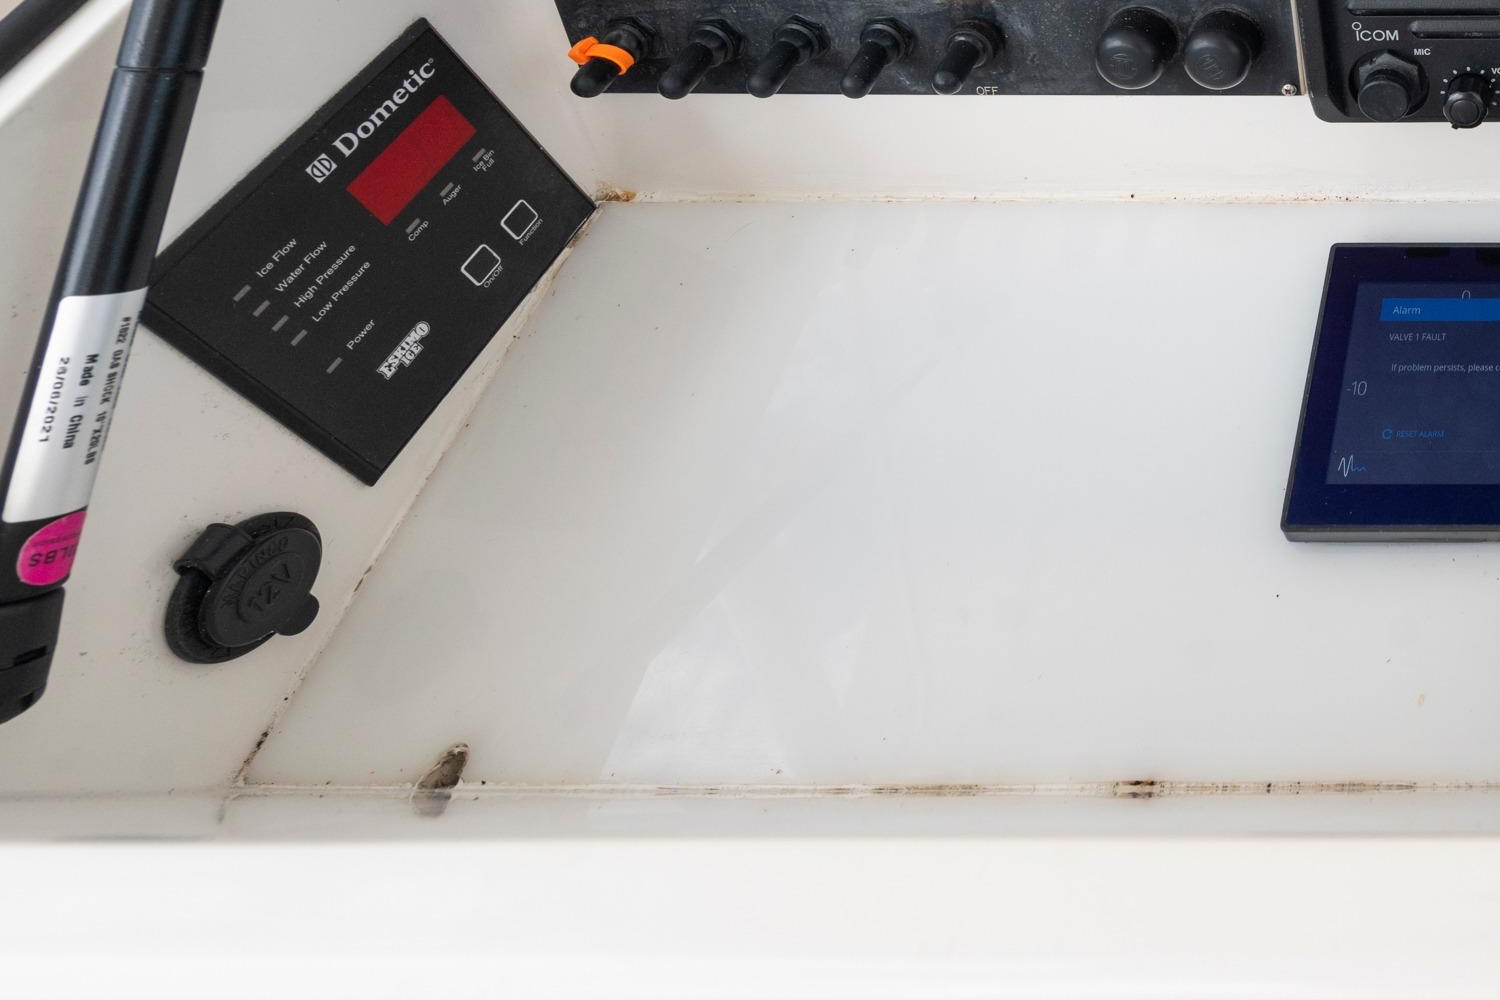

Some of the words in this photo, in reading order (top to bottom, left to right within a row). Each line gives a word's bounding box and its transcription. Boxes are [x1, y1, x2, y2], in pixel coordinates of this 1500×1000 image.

[976, 86, 999, 95] OFF
[331, 60, 435, 158] Dometic
[472, 161, 484, 172] Ice
[483, 150, 495, 161] Bin
[481, 159, 495, 172] Full
[442, 184, 462, 207] Auger
[408, 220, 429, 242] Comp
[518, 218, 543, 246] Function
[256, 262, 274, 278] Ice
[272, 238, 297, 263] Flow
[274, 263, 305, 293] Water
[303, 241, 327, 265] Flow
[293, 284, 318, 308] High
[315, 245, 356, 285] Pressure
[483, 265, 504, 288] On/Off
[312, 301, 333, 322] Low
[331, 261, 371, 302] Pressure
[1392, 306, 1421, 315] Alarm
[346, 319, 376, 350] Power
[1389, 333, 1413, 341] VALVE
[1421, 333, 1447, 341] FAULT
[79, 354, 99, 386] Made
[1391, 363, 1398, 372] If
[1398, 363, 1432, 373] problem
[1434, 363, 1466, 373] persists,
[1468, 363, 1494, 373] please
[63, 414, 83, 449] China
